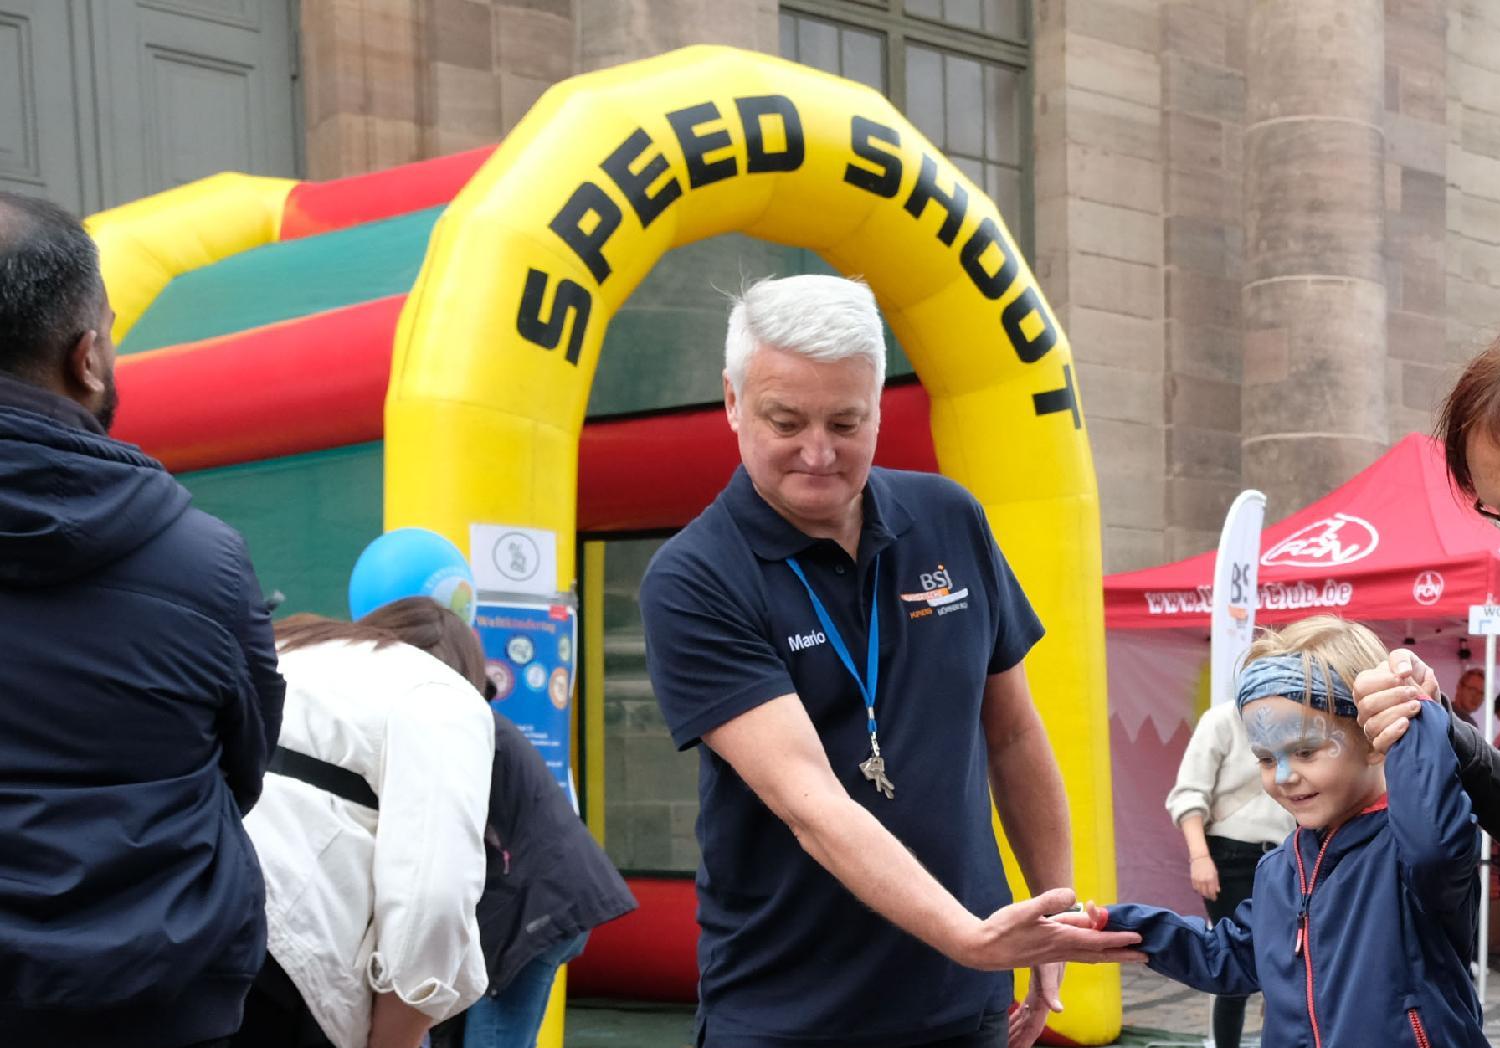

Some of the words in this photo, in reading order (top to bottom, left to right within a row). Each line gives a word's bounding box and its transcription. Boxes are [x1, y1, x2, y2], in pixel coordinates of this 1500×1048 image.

[516, 94, 805, 368] SPEED
[844, 115, 1082, 430] SHOOT
[788, 629, 826, 652] Mario
